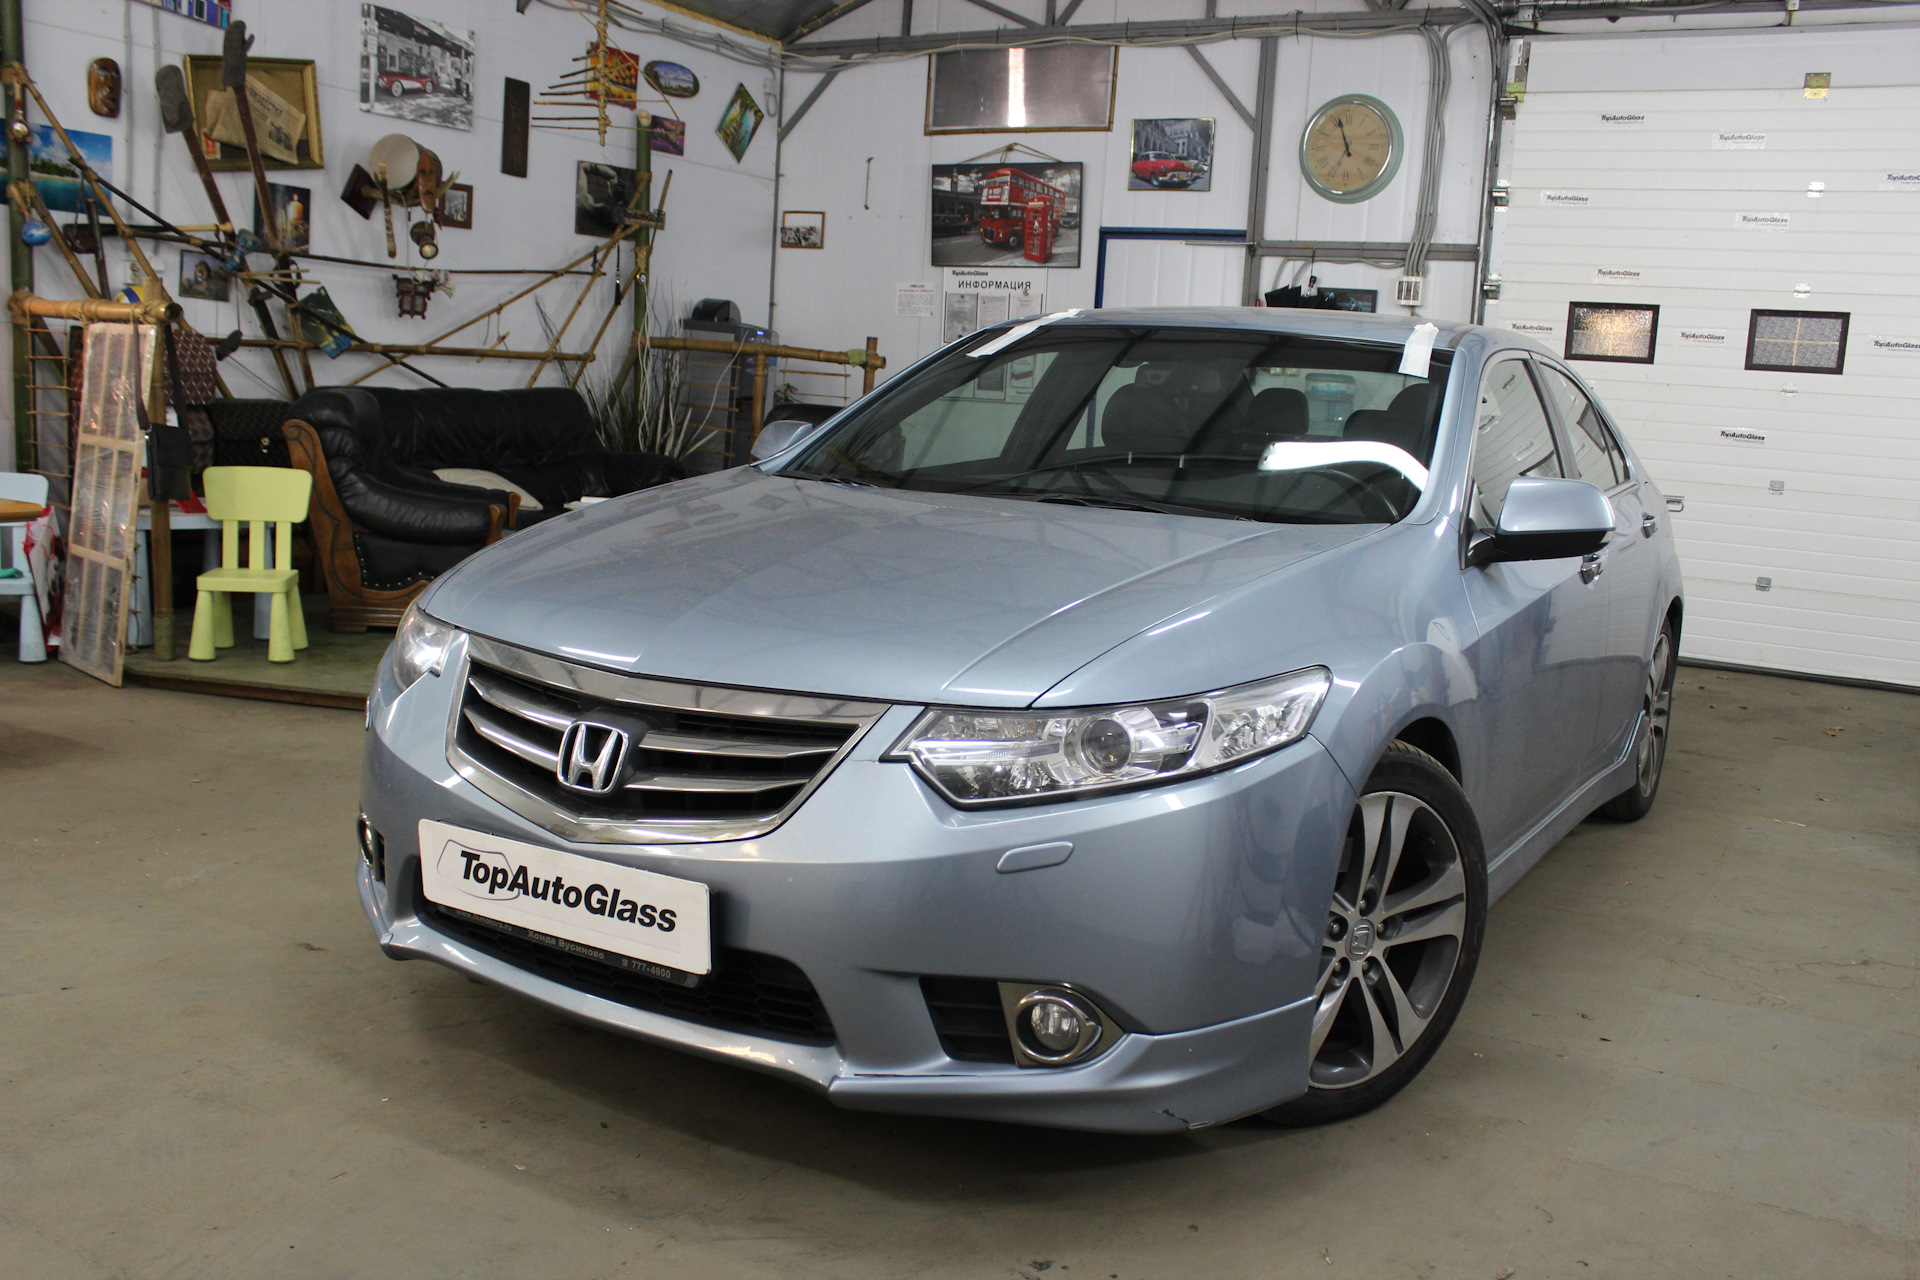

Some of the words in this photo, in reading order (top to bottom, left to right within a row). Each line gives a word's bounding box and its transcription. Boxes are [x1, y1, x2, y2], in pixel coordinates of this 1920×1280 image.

[1601, 114, 1645, 122] TopAutoGlass
[1718, 133, 1766, 142] TopAutoGlass
[1546, 194, 1589, 202] TopAutoGlass
[1741, 215, 1789, 224] TopAutoGlass
[951, 269, 989, 277] TopAutoGlass
[1597, 268, 1641, 277] TopAutoGlass
[958, 280, 1031, 292] ИНФОРМАЦИЯ
[1511, 323, 1553, 332] TopAutoGlass
[1680, 331, 1725, 341] TopAutoGlass
[1720, 430, 1766, 441] TopAutoGlass
[460, 850, 677, 932] TopAutoGlass
[528, 930, 557, 946] Хонда
[558, 938, 605, 960] Бусиново
[632, 960, 672, 979] 777-4800
